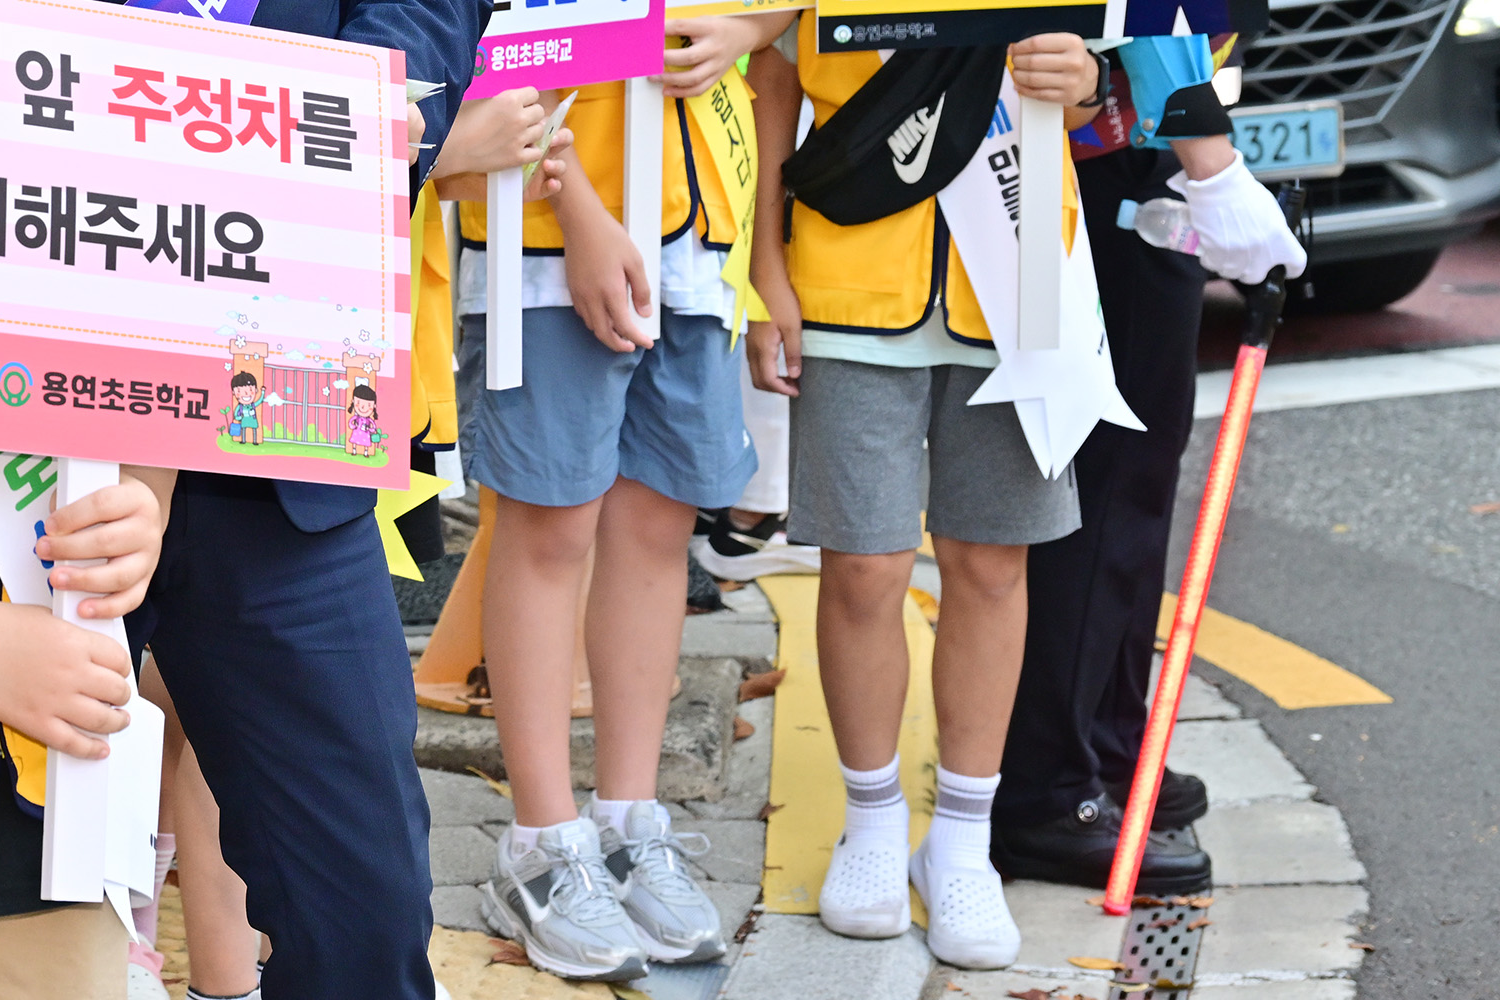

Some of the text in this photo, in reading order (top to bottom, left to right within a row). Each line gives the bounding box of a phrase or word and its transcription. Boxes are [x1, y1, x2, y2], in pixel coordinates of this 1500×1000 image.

[490, 37, 573, 72] 용연초등학교
[16, 50, 80, 132] 앞
[107, 63, 358, 172] 주정차를
[887, 106, 934, 163] NIKE
[42, 371, 211, 421] 용연초등학교
